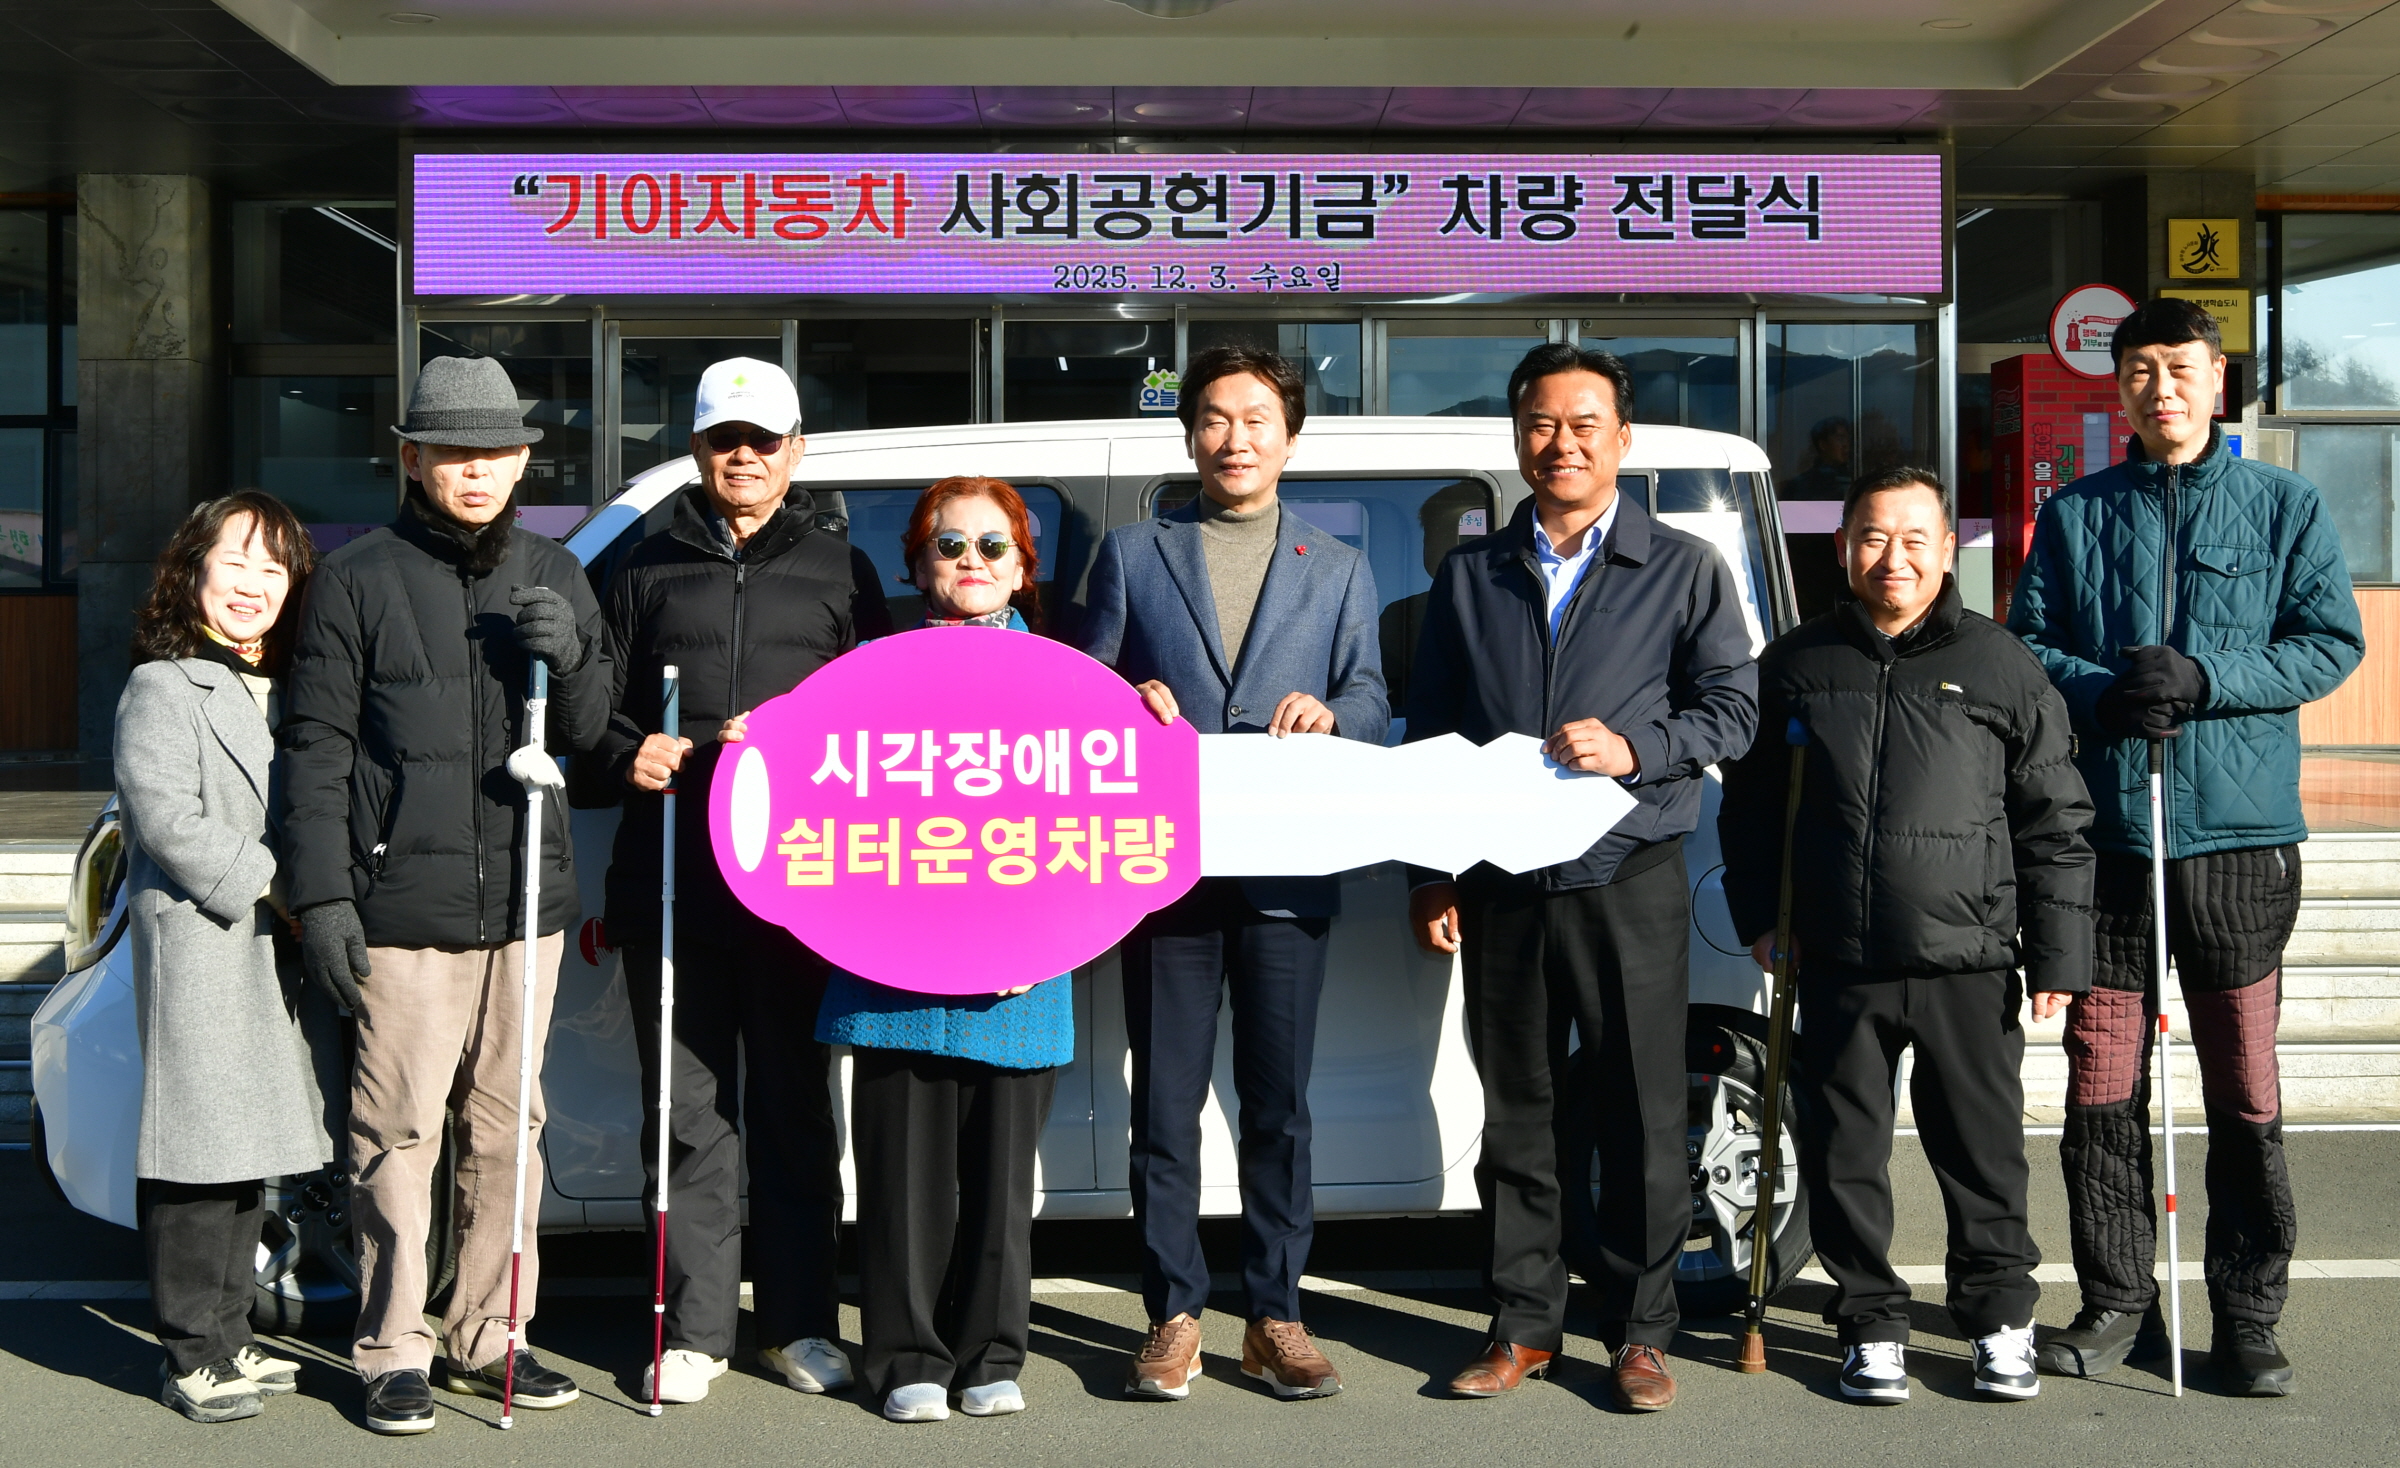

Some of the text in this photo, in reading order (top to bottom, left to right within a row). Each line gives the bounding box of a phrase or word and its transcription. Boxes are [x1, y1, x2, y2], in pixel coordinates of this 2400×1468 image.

[512, 172, 1822, 242] “기아자동차 사회공헌기금” 차량 전달식
[1053, 262, 1342, 292] 2025. 12. 3. 수요일
[1142, 388, 1180, 407] 오늘
[2056, 444, 2076, 491] 기부
[810, 728, 1139, 797] 시각장애인
[777, 815, 1175, 886] 쉼터운영차량
